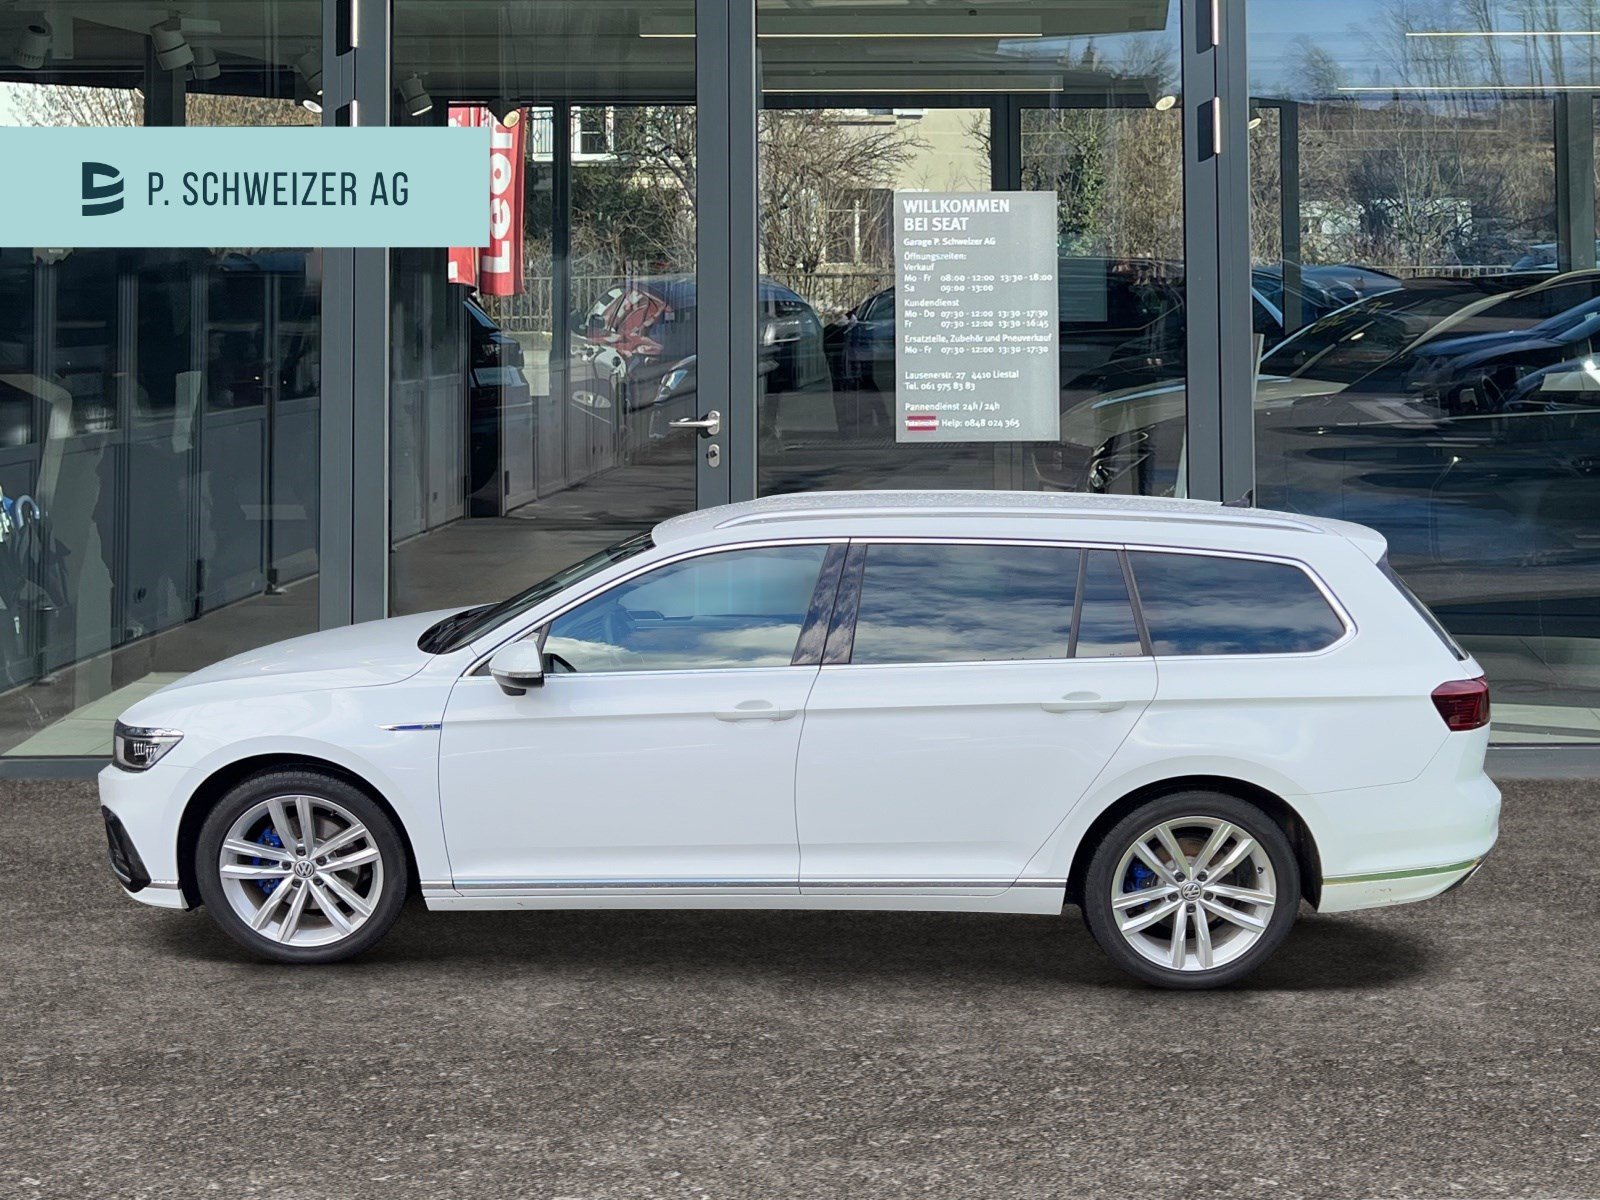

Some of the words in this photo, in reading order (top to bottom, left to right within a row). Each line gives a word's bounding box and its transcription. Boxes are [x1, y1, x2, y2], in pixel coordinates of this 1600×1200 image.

[903, 199, 1010, 213] WILLKOMMEN
[904, 218, 927, 231] BEI
[932, 217, 969, 231] SEAT
[904, 238, 932, 247] Garage
[904, 263, 935, 271] Verkauf
[941, 274, 965, 282] 08:00
[941, 285, 965, 293] 09:00
[904, 299, 960, 307] Kundendienst
[905, 310, 917, 318] Mo
[941, 311, 964, 319] 07:30
[1027, 310, 1048, 318] 17:30
[905, 335, 948, 344] Ersatzteile,
[951, 334, 983, 342] Zubehör
[1002, 333, 1052, 342] Pneuverkauf
[971, 372, 991, 380] 4410
[993, 370, 1019, 378] Liestal
[905, 382, 918, 390] Tel.
[937, 383, 951, 391] 975
[953, 382, 963, 391] 83
[965, 382, 975, 390] 83
[963, 402, 978, 411] 24h
[984, 402, 1000, 411] 24h
[942, 419, 962, 427] Help:
[965, 419, 985, 427] 0848
[1005, 419, 1020, 428] 365
